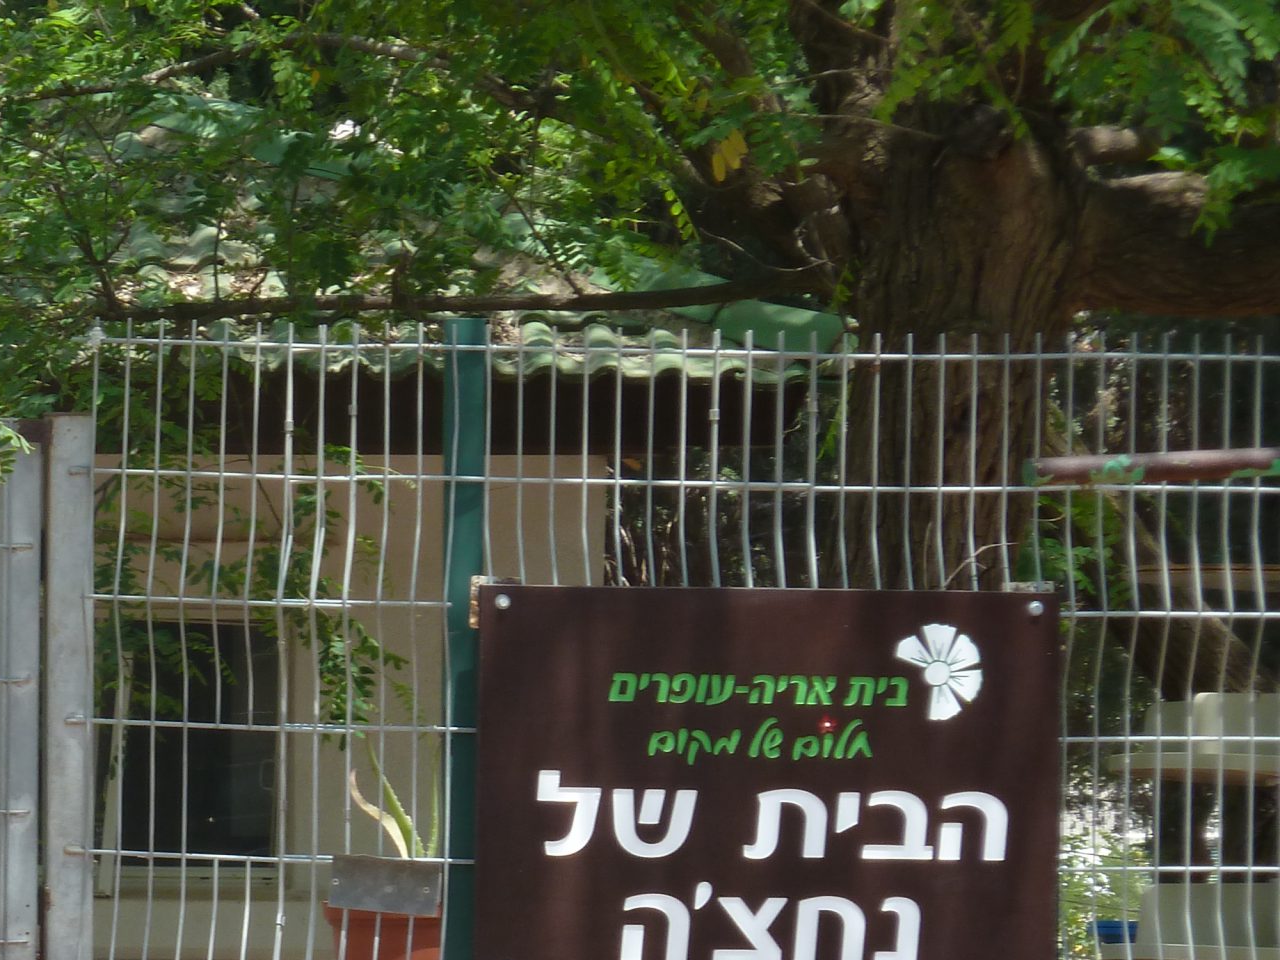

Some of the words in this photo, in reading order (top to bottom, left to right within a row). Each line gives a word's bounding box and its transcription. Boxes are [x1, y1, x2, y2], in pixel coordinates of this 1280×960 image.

[607, 672, 837, 707] אריה-עופרים
[842, 676, 909, 708] בית
[647, 728, 742, 766] מקום
[748, 717, 786, 759] של
[791, 717, 873, 761] חלום
[536, 769, 699, 859] של
[742, 788, 1009, 862] הבית
